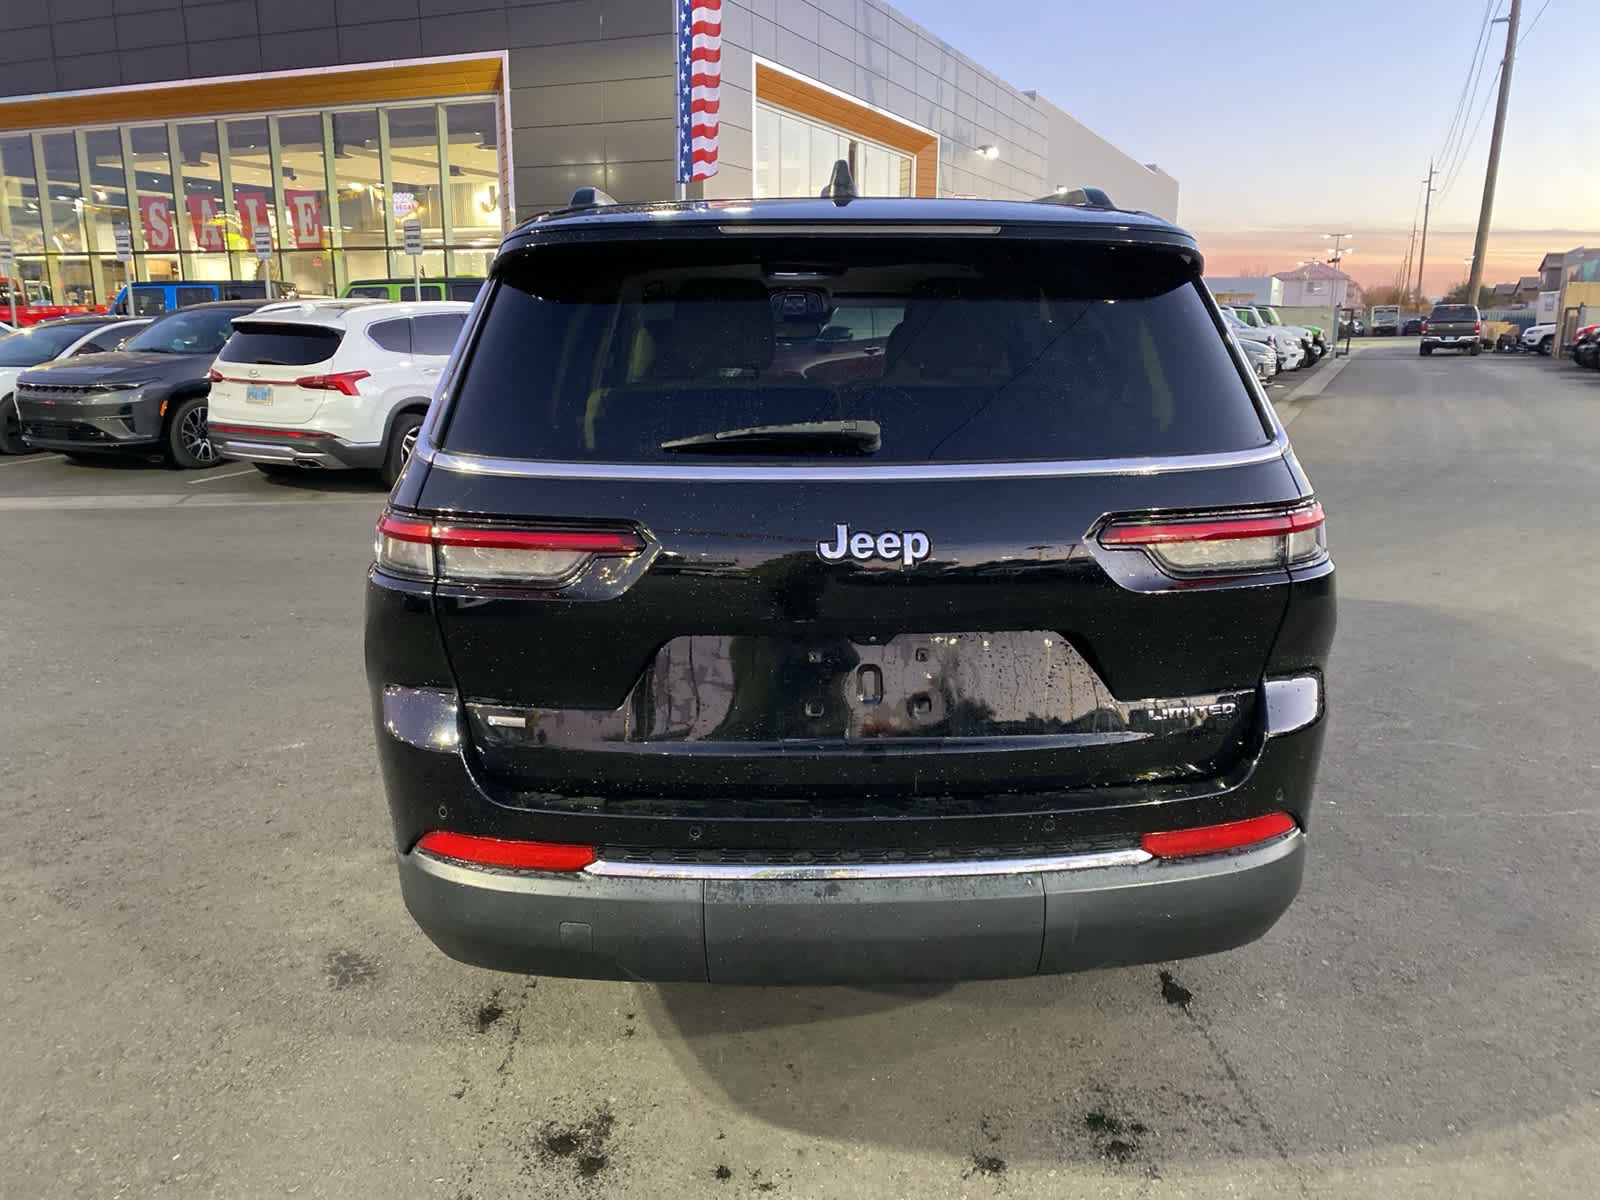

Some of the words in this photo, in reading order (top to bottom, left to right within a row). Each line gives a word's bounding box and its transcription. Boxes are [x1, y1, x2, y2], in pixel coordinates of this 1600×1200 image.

[148, 196, 320, 246] SALE
[818, 523, 931, 565] Jeep
[1147, 700, 1236, 721] LIMITED
